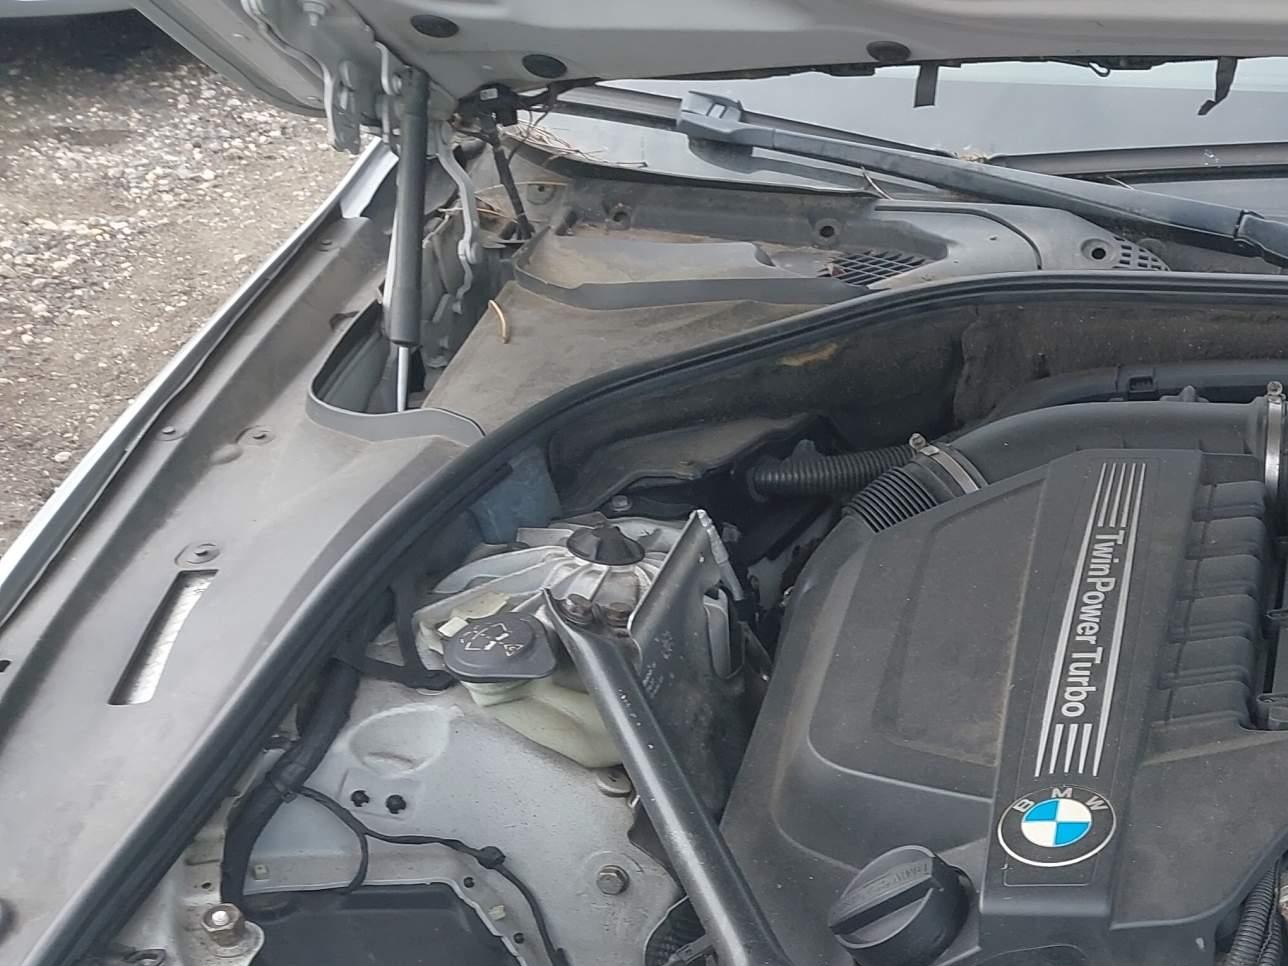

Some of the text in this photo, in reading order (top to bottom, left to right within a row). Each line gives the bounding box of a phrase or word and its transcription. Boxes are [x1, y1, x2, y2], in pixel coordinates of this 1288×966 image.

[1061, 529, 1126, 718] TwinPower Turbo
[1012, 787, 1110, 813] BMW
